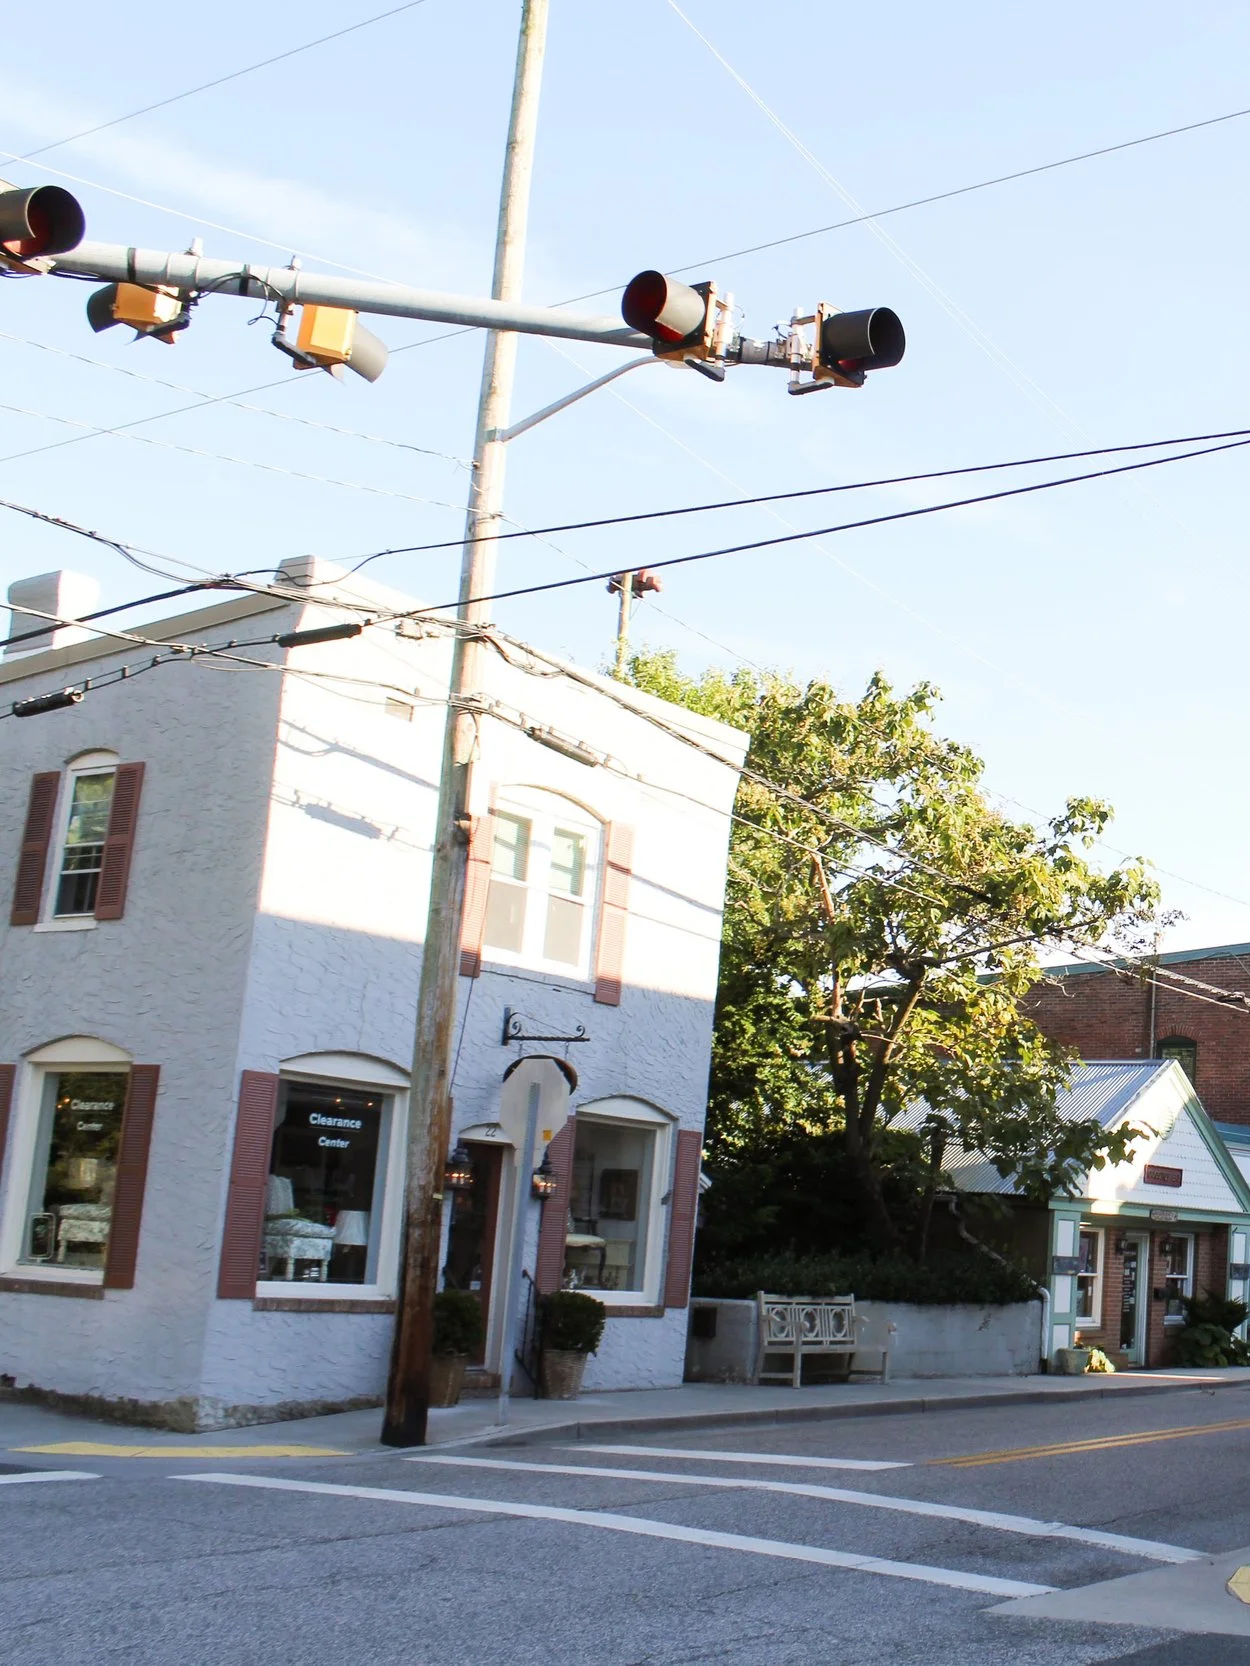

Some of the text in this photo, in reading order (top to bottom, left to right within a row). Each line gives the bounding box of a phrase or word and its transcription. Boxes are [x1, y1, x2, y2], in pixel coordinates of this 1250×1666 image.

[309, 1113, 362, 1129] Clearance
[485, 1127, 497, 1137] 22
[318, 1136, 350, 1148] Center
